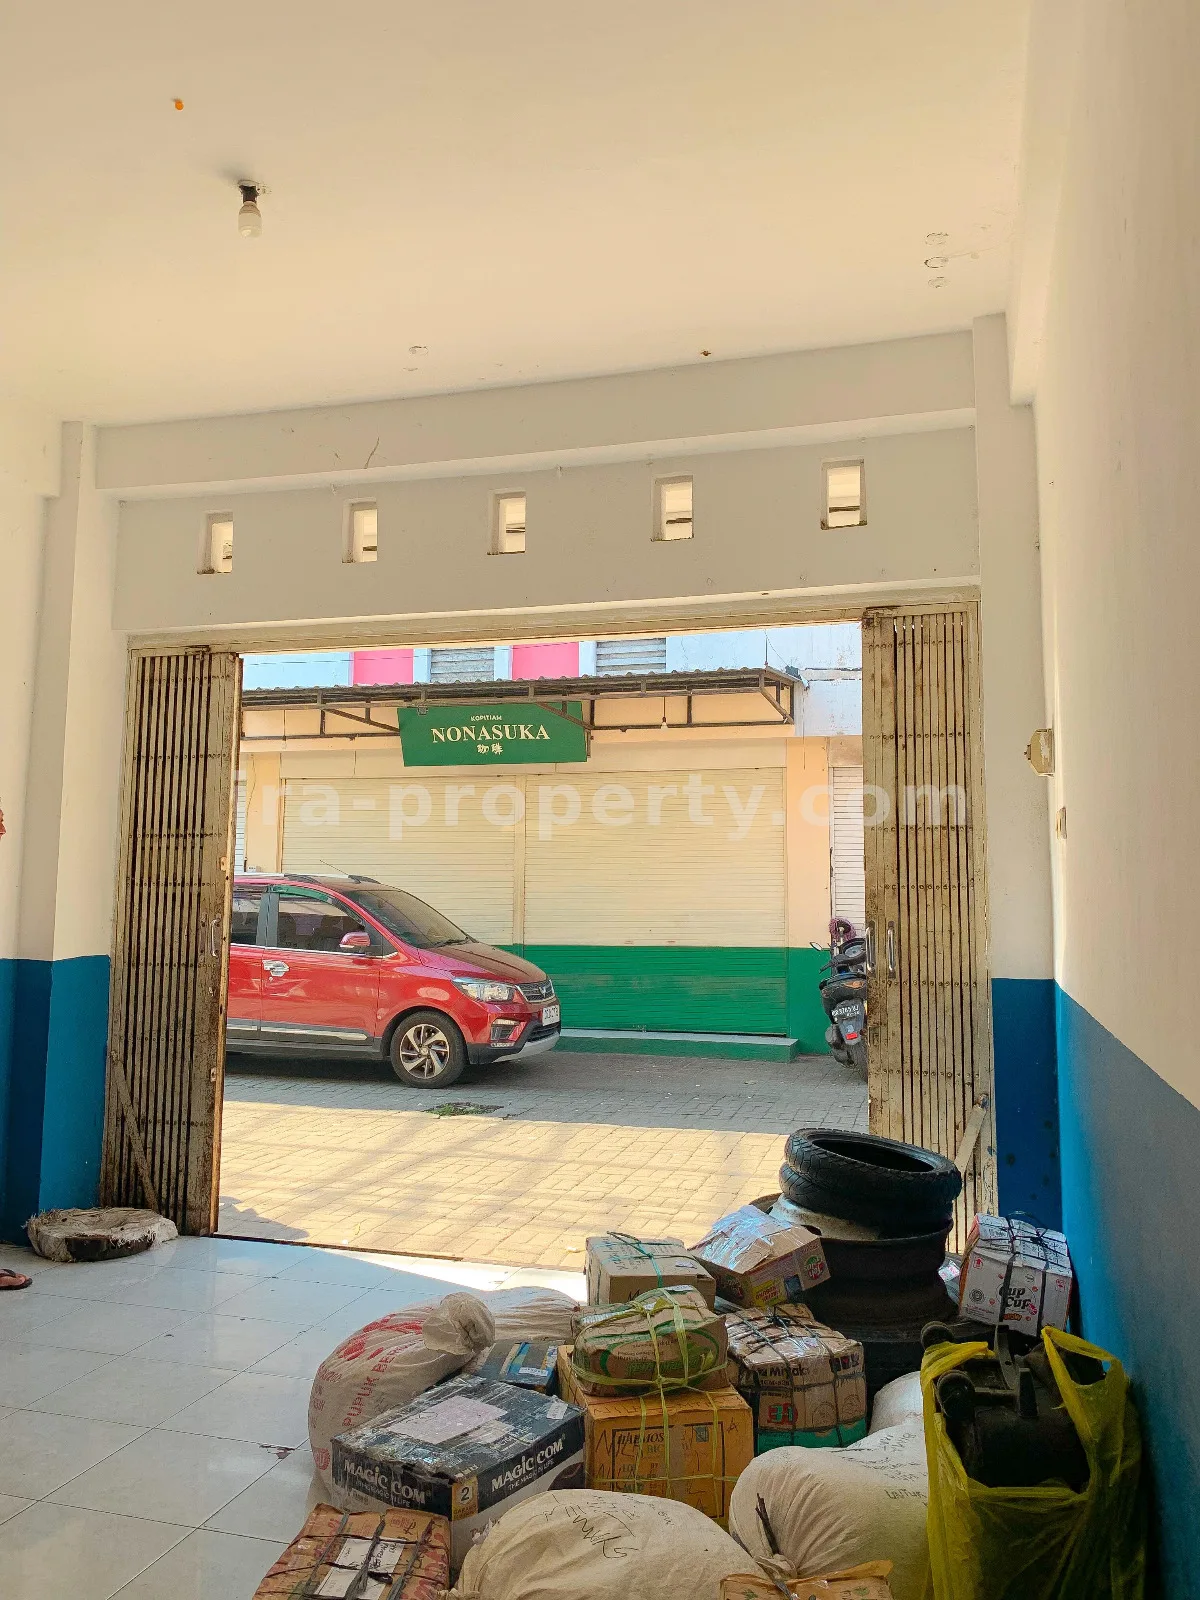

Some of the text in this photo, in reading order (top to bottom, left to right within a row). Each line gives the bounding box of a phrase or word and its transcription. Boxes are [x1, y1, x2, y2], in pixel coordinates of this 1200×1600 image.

[470, 714, 502, 722] KOPITIAM
[431, 724, 551, 743] NONASUKA
[342, 1376, 380, 1427] PUPUK
[536, 1438, 564, 1464] COM
[391, 1480, 426, 1504] COM
[461, 1486, 470, 1502] 2
